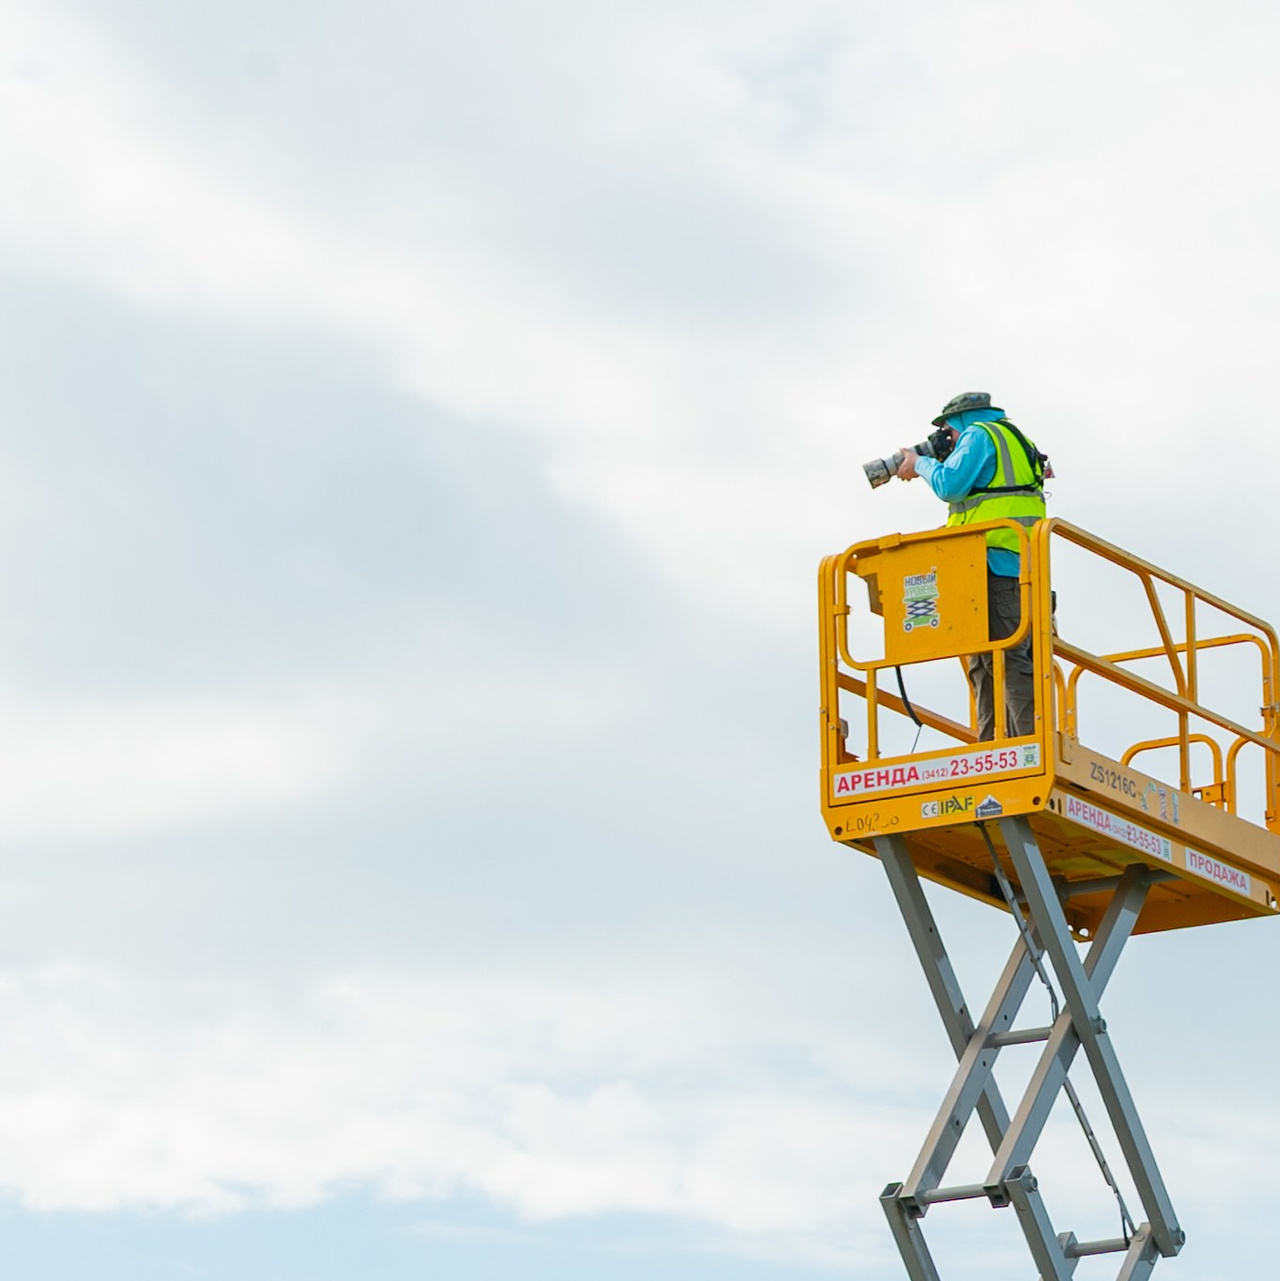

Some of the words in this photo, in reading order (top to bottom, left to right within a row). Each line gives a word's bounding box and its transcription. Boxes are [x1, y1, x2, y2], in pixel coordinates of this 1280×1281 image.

[837, 766, 919, 793] АРЕНДА
[921, 768, 949, 781] (3412)
[950, 750, 1018, 777] 23-55-53
[1090, 762, 1137, 799] ZS1216C
[940, 796, 974, 815] IPAF
[1068, 798, 1111, 831] АРЕНДА
[1126, 825, 1162, 855] 23-55-53
[1189, 852, 1248, 891] ПРОДАЖА
